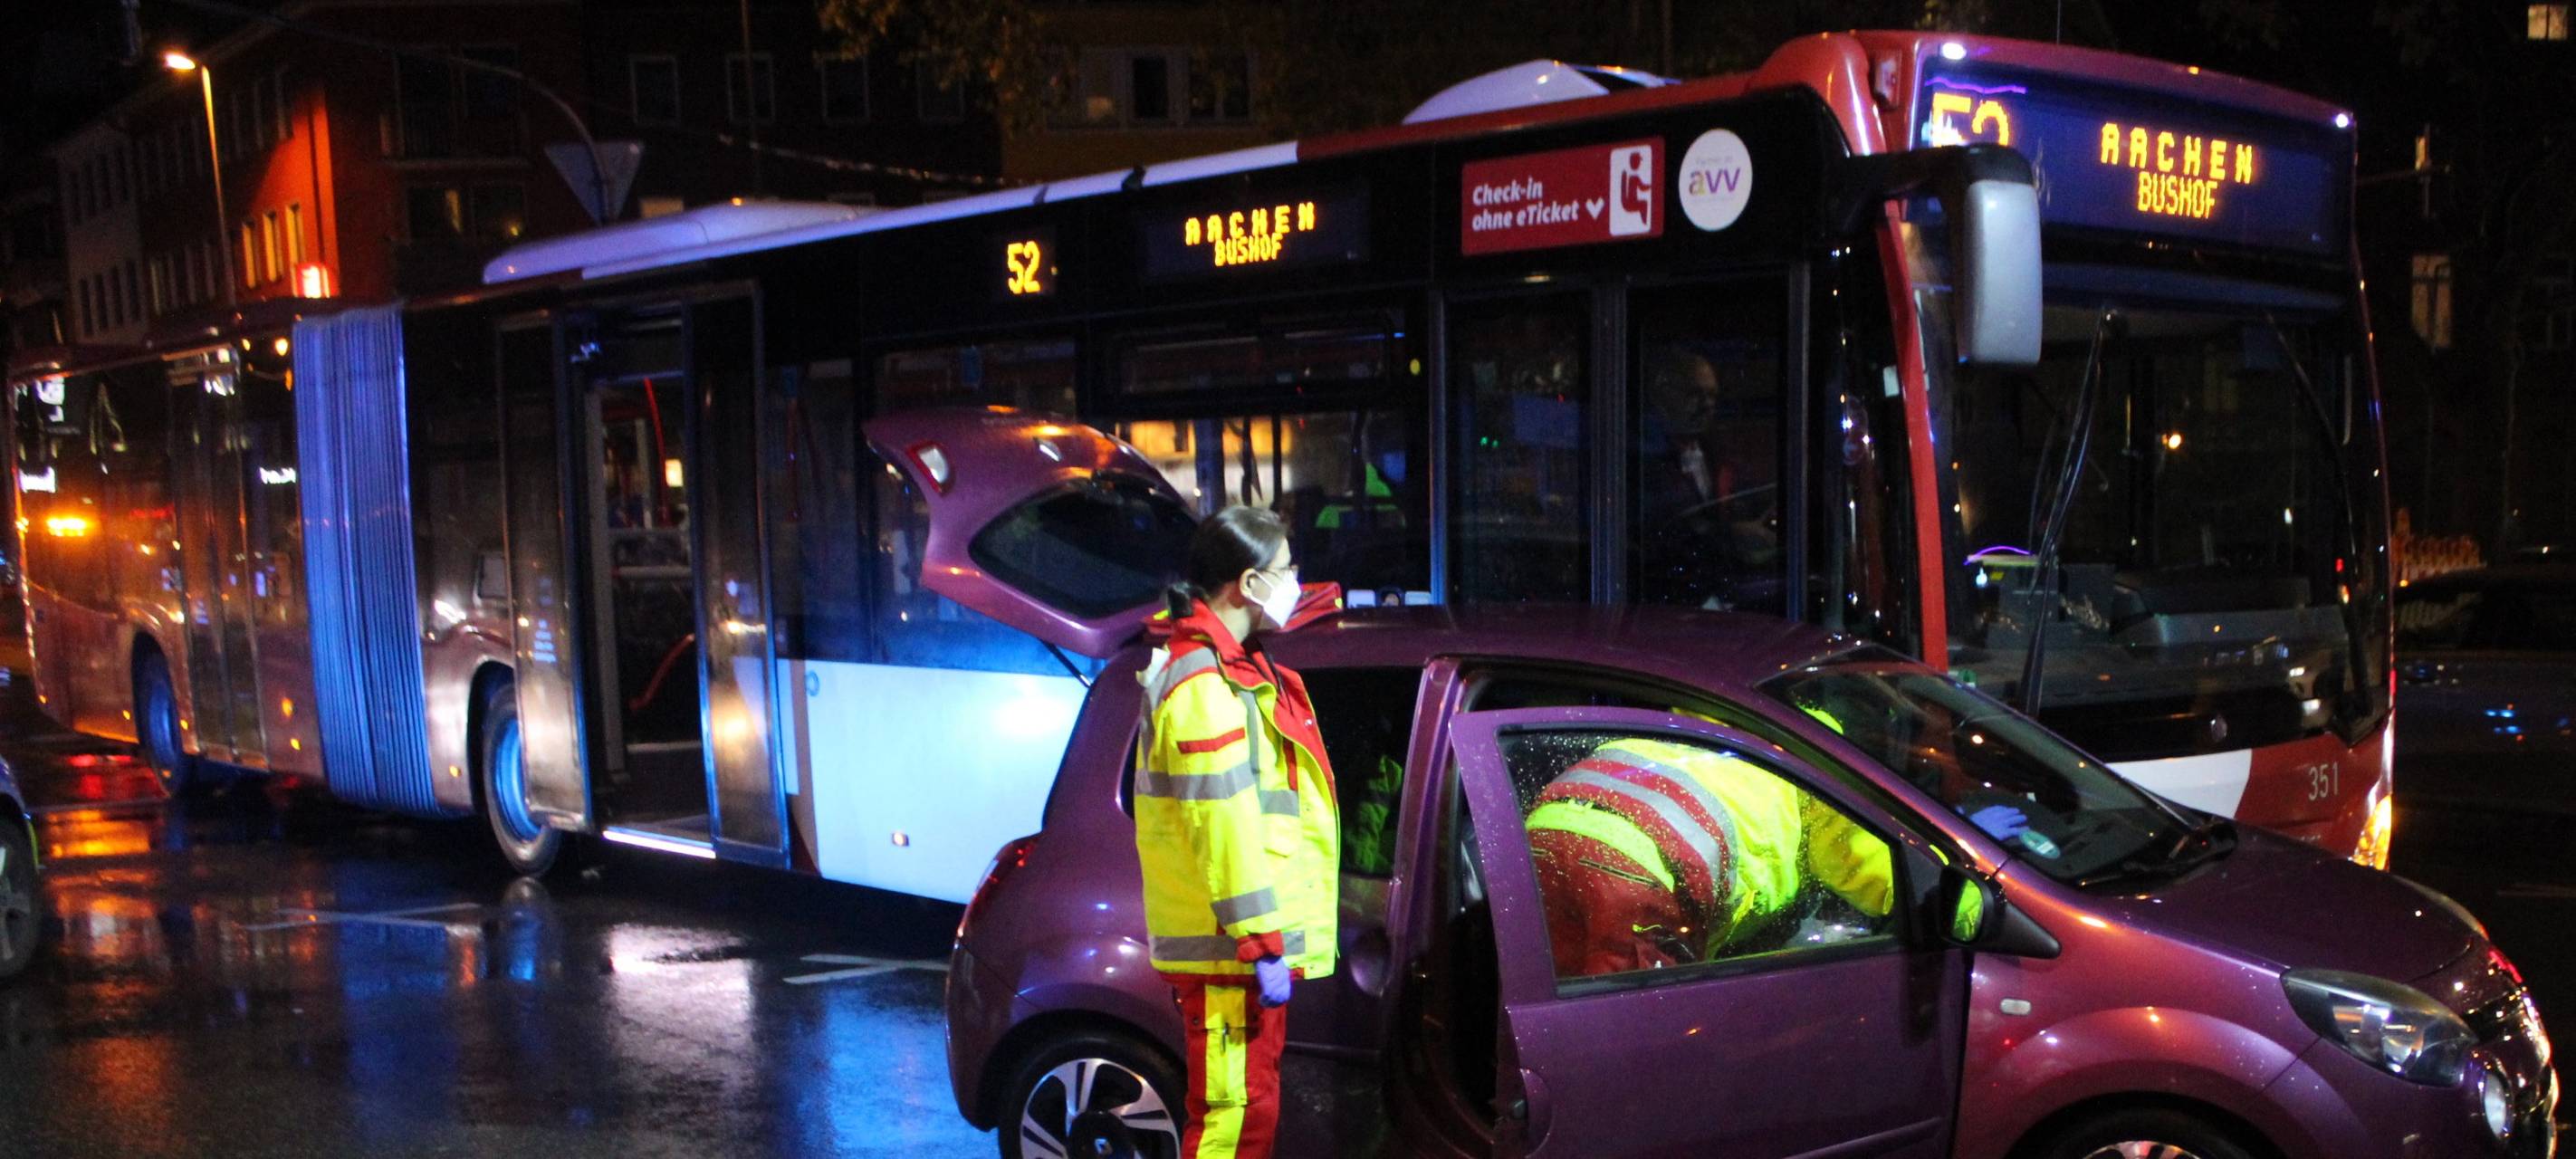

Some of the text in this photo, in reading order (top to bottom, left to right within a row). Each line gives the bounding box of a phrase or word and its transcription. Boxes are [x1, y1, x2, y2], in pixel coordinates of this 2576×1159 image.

[2101, 122, 2253, 184] AACHEN
[1472, 176, 1543, 206] Check-in
[1689, 167, 1741, 196] avv
[2138, 171, 2217, 219] BUSHOF
[1185, 202, 1315, 245] AACHEN
[1472, 199, 1580, 232] ohne eTicket
[1007, 241, 1040, 294] 52
[1214, 233, 1283, 266] BUSHOF
[2308, 761, 2339, 800] 351
